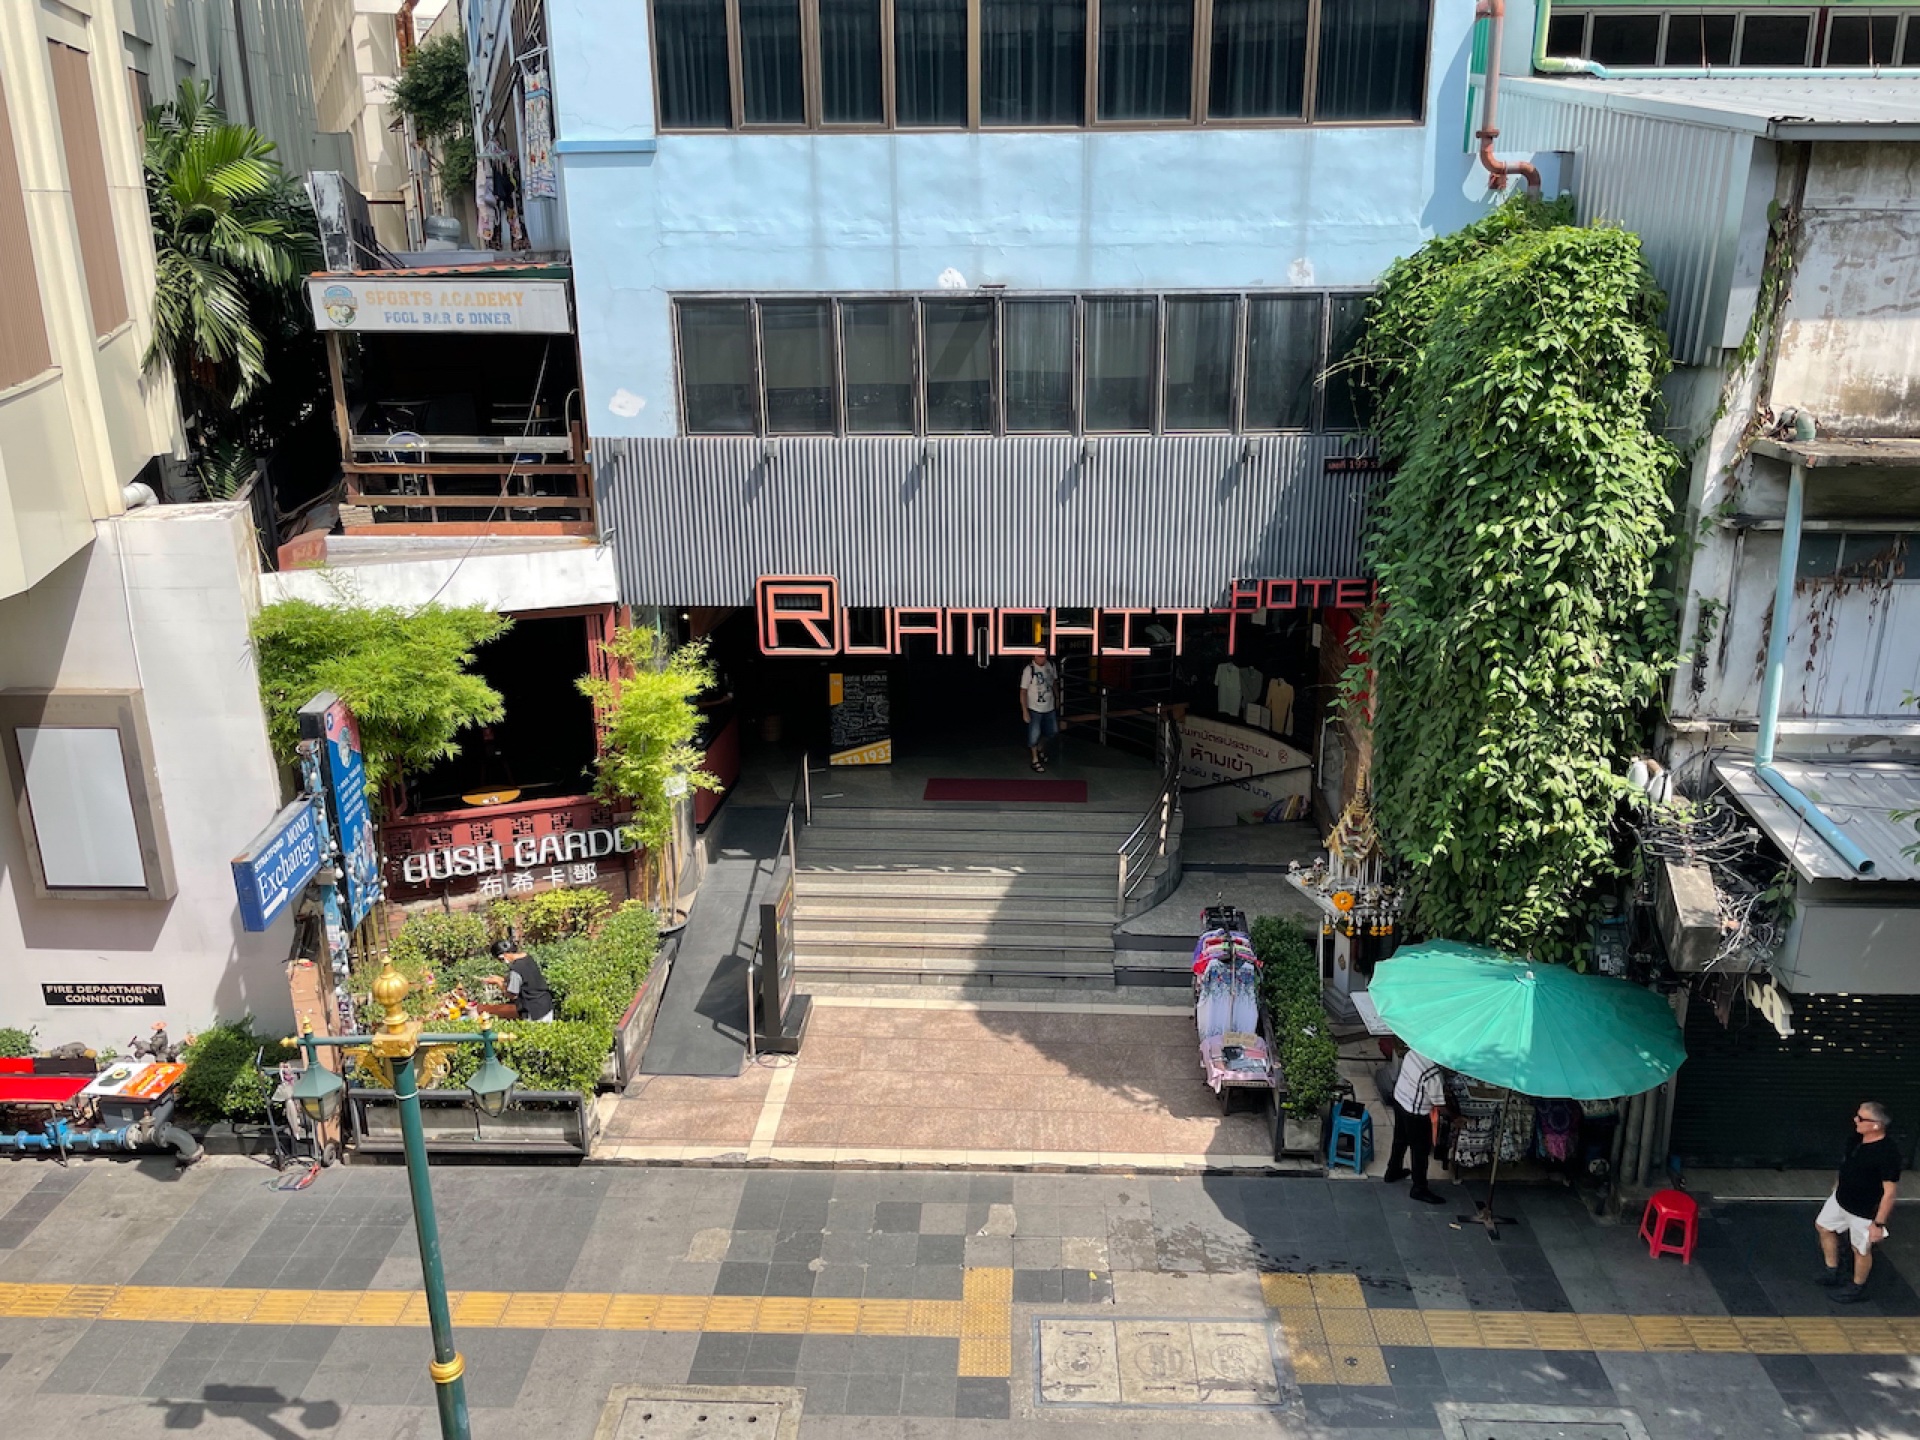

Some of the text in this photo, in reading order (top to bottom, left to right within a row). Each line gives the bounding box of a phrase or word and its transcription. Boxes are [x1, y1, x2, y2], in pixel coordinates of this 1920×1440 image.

[365, 291, 432, 306] SPORTS
[440, 291, 524, 307] ACADEMY
[384, 312, 512, 326] POOL BAR & DINER
[765, 584, 1259, 656] RUAMCHITT
[257, 832, 315, 905] Exchange
[403, 842, 503, 883] BUSH
[46, 985, 160, 994] FIRE DEPARTMENT
[65, 995, 144, 1003] CONNECTION
